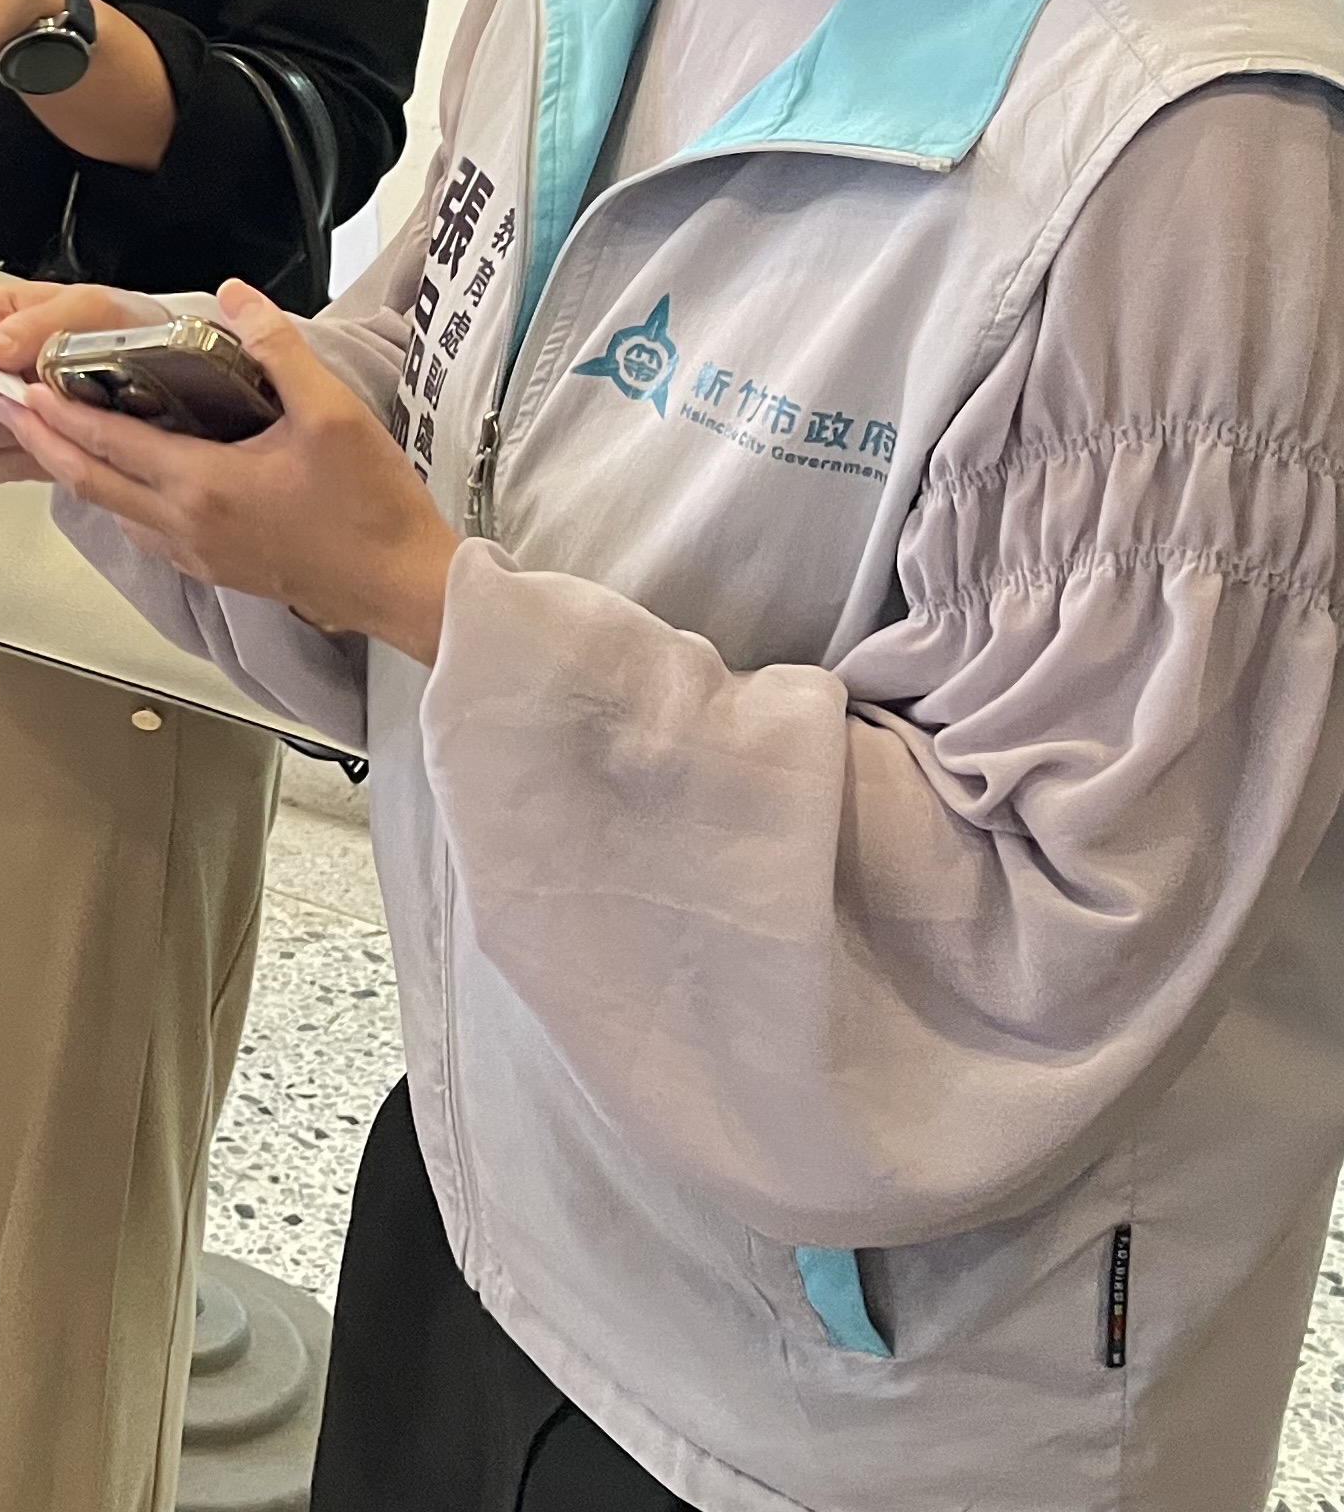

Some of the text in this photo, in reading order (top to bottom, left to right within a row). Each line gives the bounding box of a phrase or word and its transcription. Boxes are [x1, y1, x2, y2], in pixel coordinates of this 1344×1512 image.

[413, 208, 516, 485] 教育處副處
[691, 360, 899, 464] 新竹市政府
[771, 445, 890, 485] Governmen
